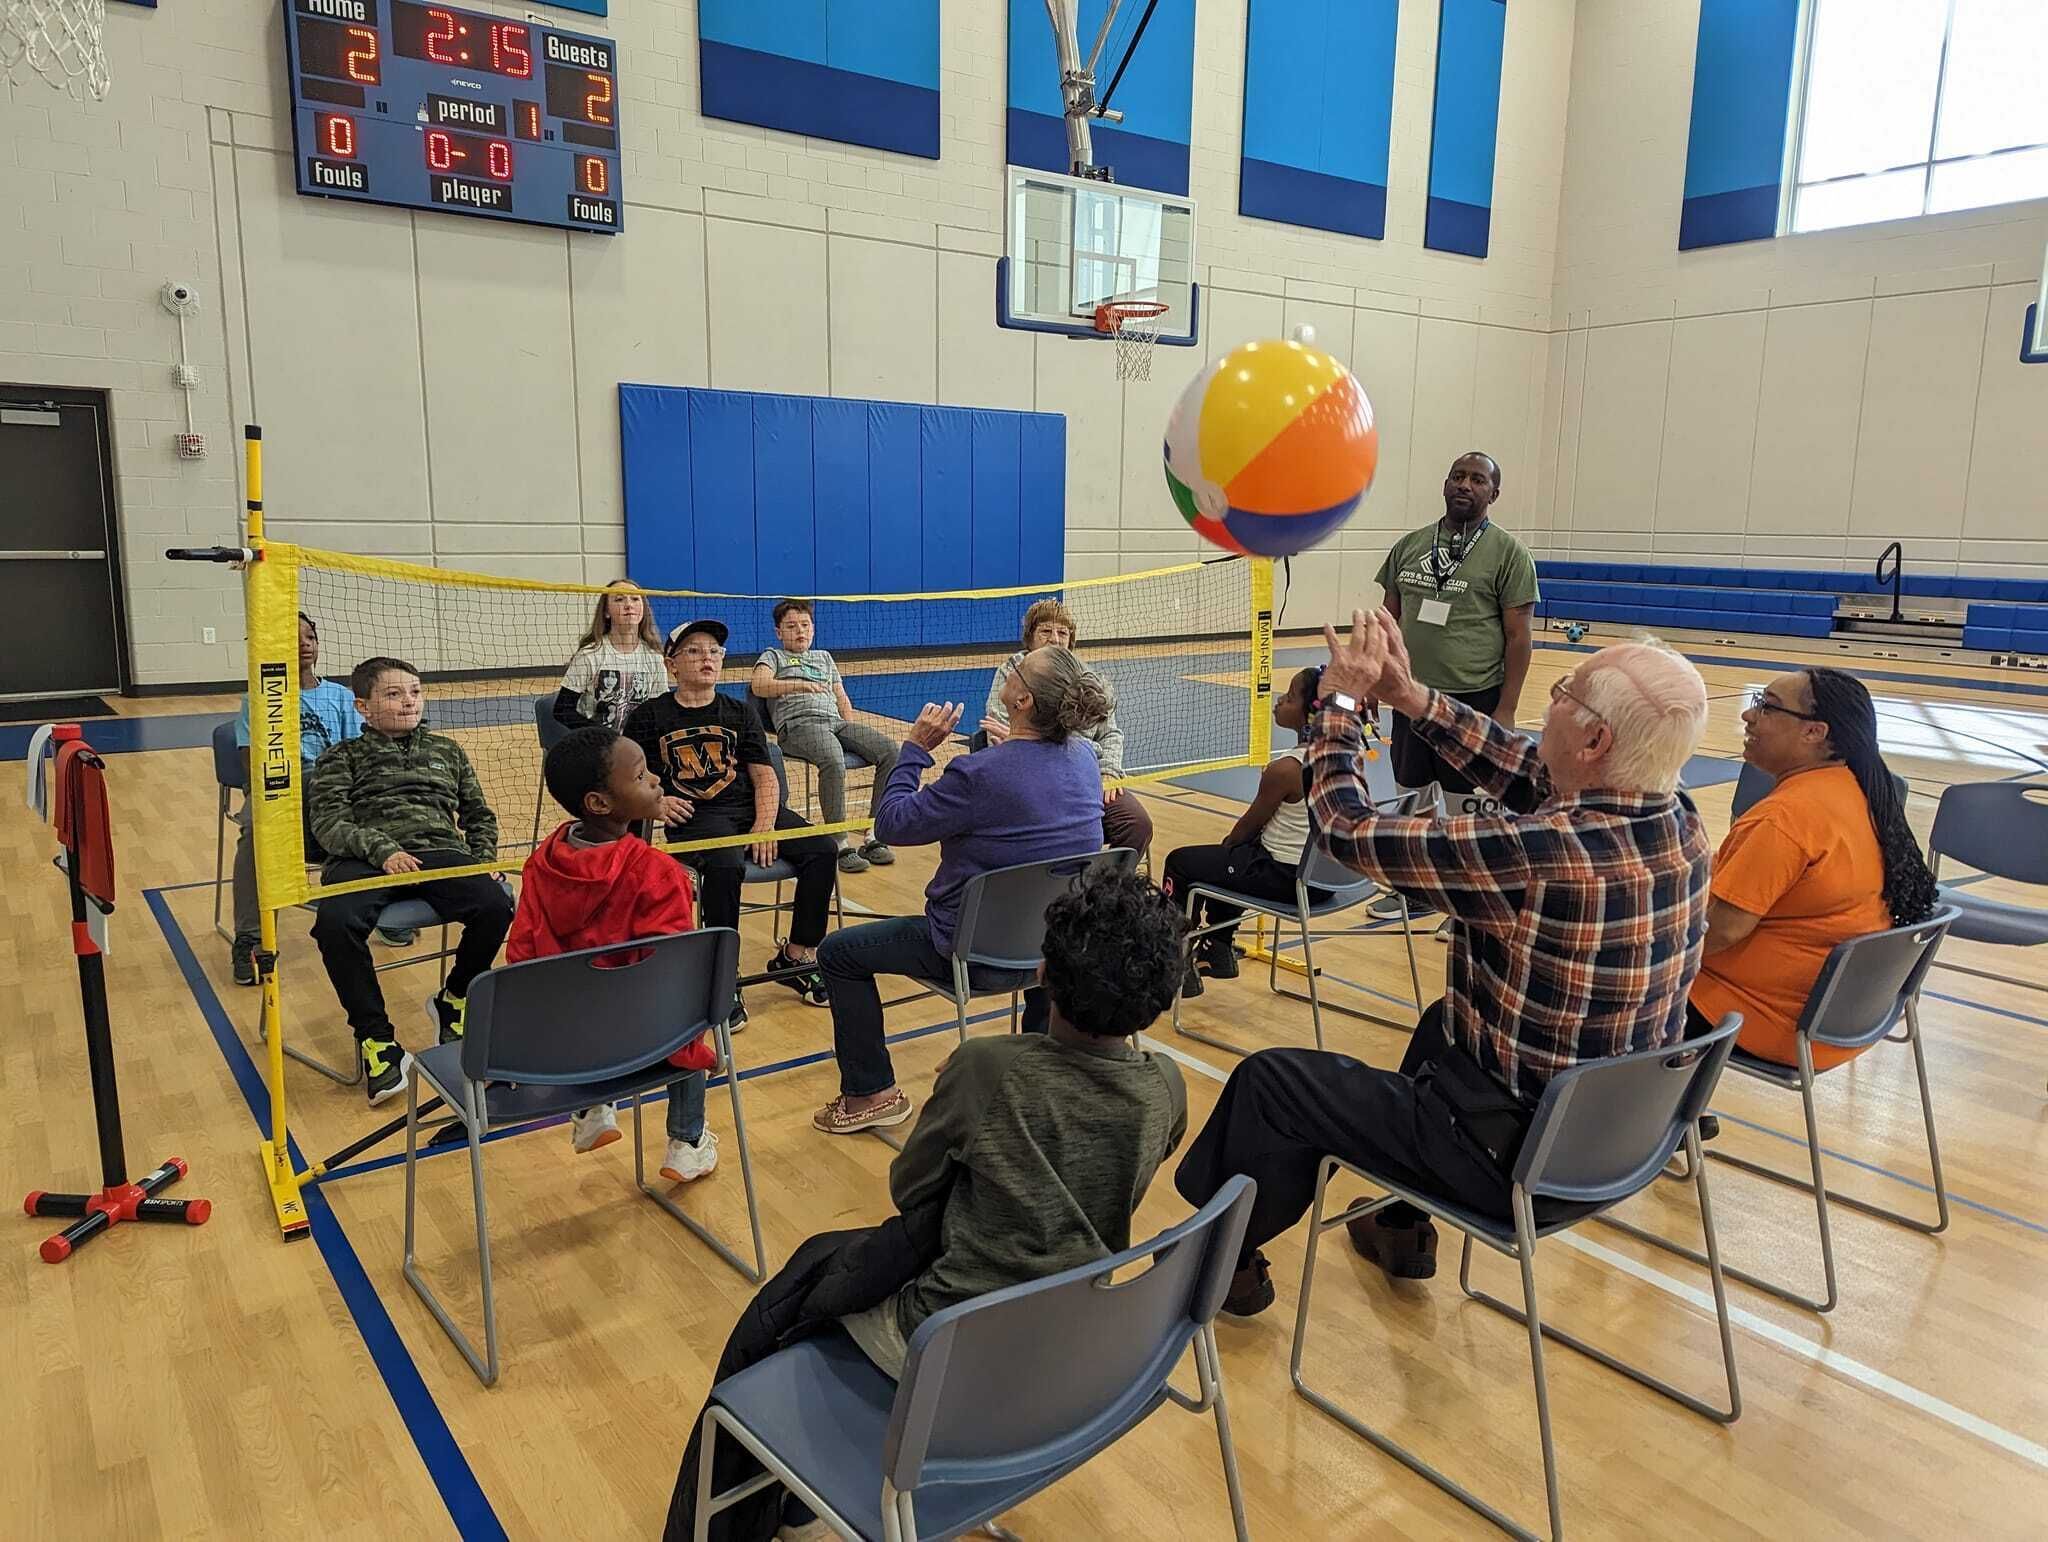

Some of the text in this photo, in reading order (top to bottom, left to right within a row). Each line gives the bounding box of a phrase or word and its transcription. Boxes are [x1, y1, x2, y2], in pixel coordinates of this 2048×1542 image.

[347, 28, 376, 81] 2
[427, 9, 530, 76] 2:15
[547, 36, 608, 69] Guests
[438, 100, 495, 126] period
[586, 74, 610, 123] 2
[329, 116, 352, 155] 0
[530, 106, 538, 138] 1
[315, 161, 363, 188] fouls
[586, 158, 605, 192] 0
[441, 180, 502, 205] player
[574, 198, 613, 223] fouls
[1446, 579, 1468, 588] CLUB
[1261, 622, 1269, 681] MINI-NET
[267, 681, 285, 773] MINI-NET
